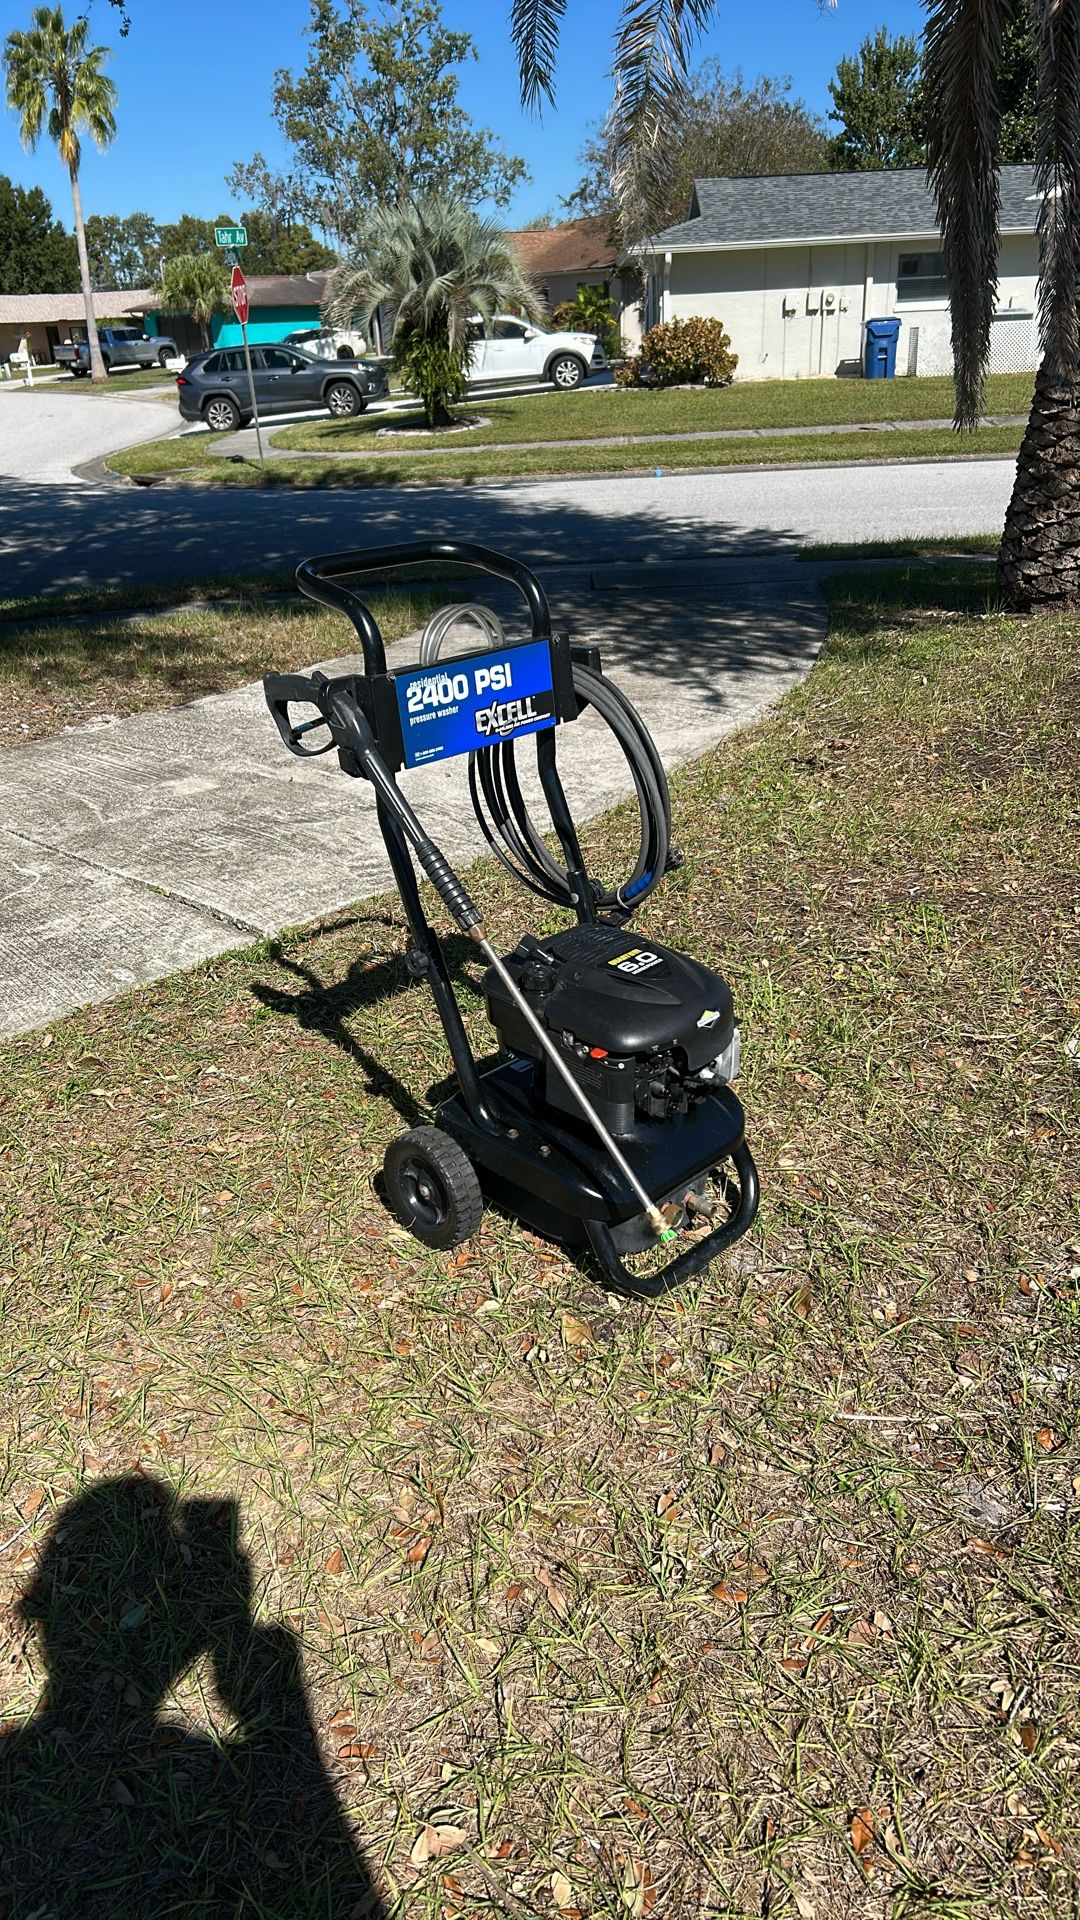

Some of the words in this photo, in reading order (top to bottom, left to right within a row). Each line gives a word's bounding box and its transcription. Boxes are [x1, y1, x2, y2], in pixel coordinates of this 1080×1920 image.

[217, 230, 232, 243] Tahr
[236, 230, 244, 243] Av
[233, 284, 246, 307] STOP
[406, 674, 469, 713] 2400
[474, 662, 512, 695] PSI
[409, 672, 449, 689] residential
[409, 711, 436, 727] pressure
[437, 705, 459, 718] washer
[475, 697, 537, 736] EXCELL
[617, 951, 658, 973] 6.0
